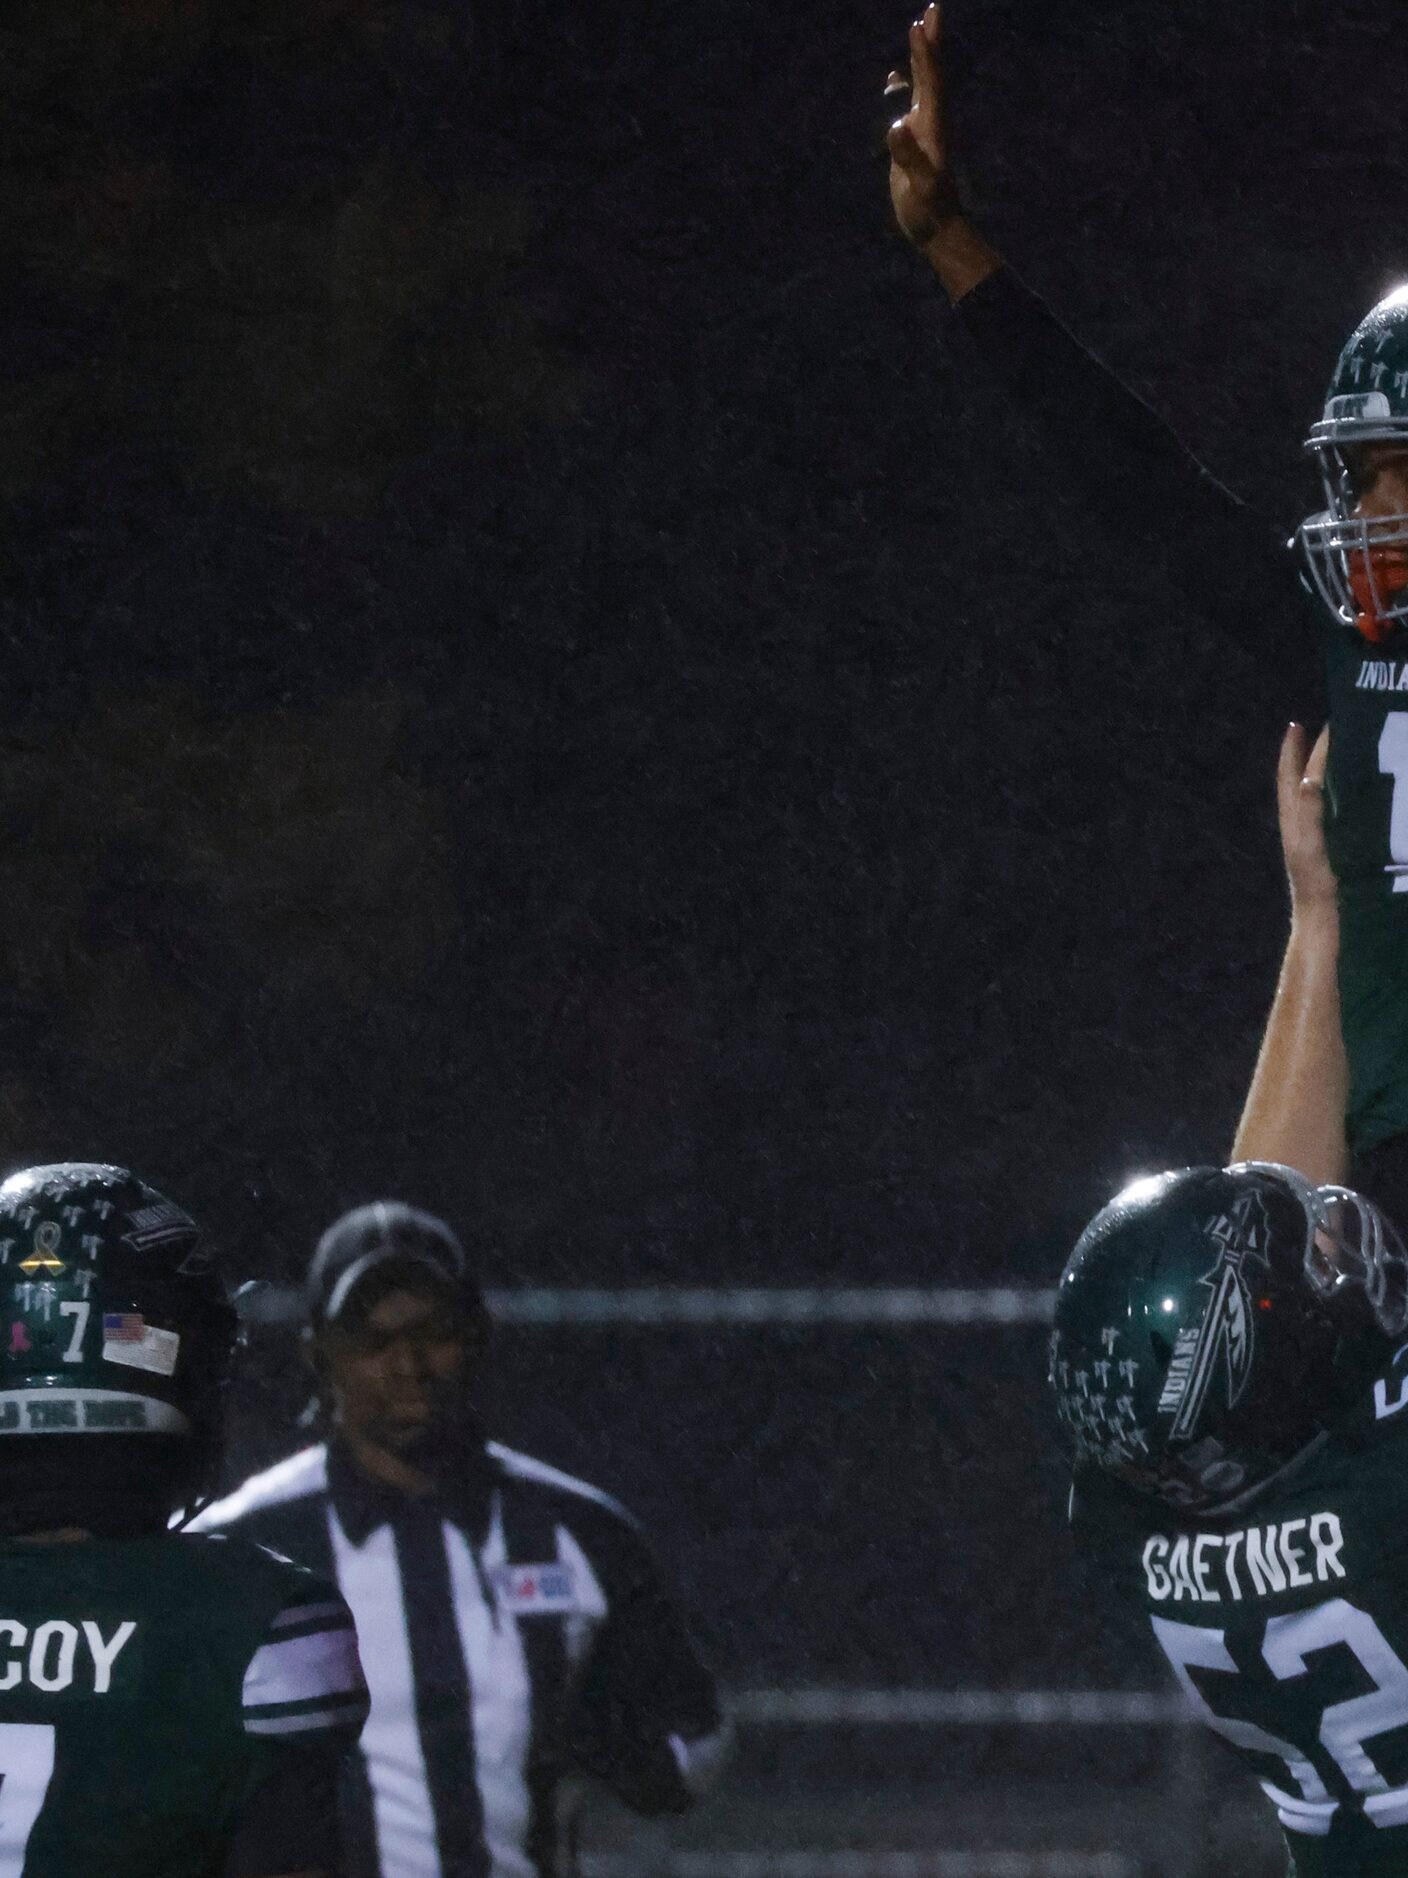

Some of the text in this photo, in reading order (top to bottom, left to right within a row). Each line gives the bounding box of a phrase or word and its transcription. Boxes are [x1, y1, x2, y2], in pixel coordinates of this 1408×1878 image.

[59, 1301, 90, 1363] 7
[1157, 1328, 1200, 1413] INDIANS
[1143, 1511, 1346, 1601] GAETNER
[0, 1618, 138, 1693] COY
